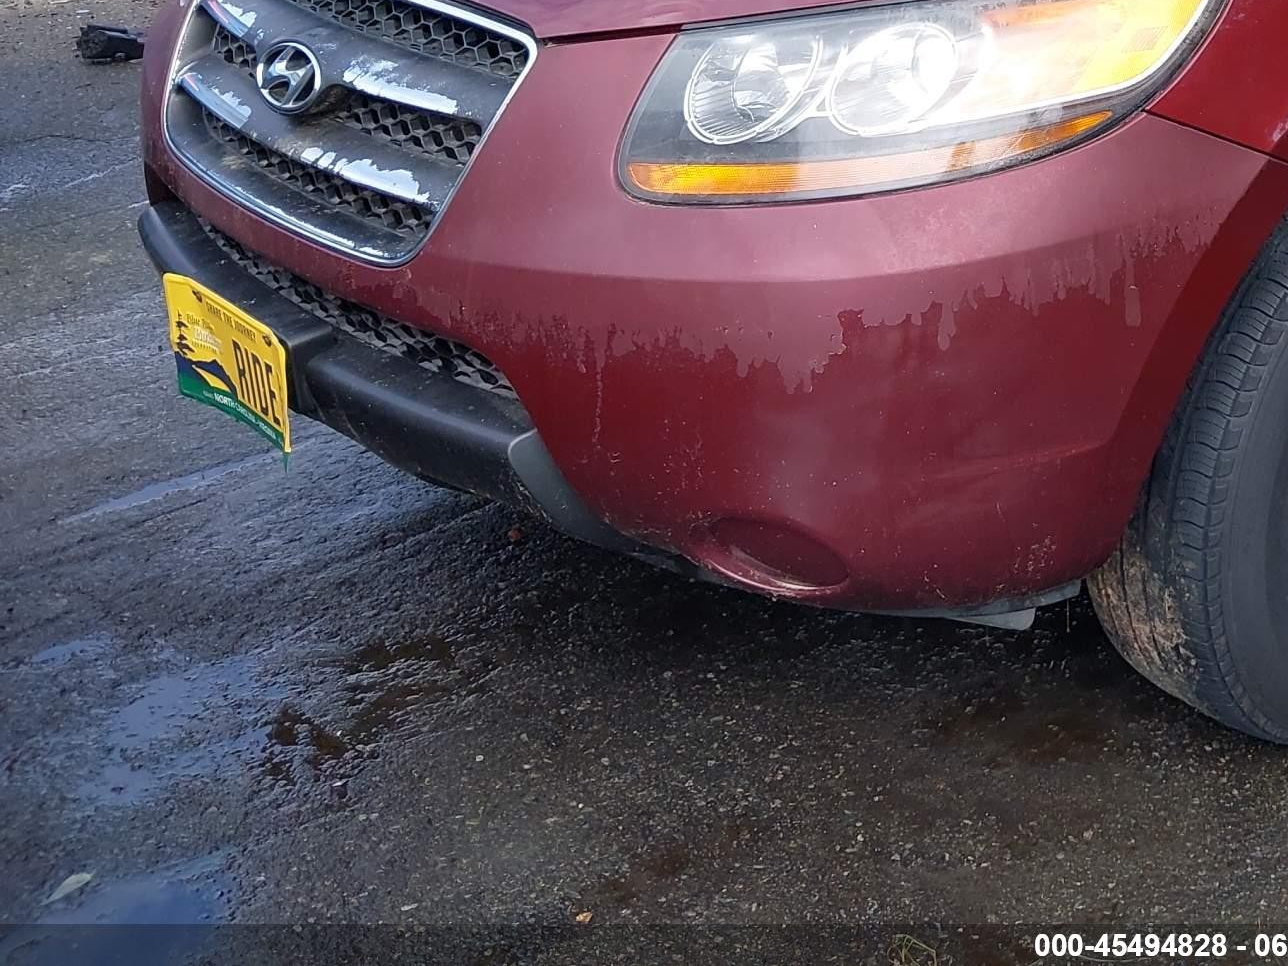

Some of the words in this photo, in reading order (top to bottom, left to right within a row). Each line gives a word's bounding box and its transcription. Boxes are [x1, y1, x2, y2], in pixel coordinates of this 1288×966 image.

[222, 311, 234, 329] THE
[232, 338, 282, 427] RIDE
[213, 392, 236, 409] NORTH
